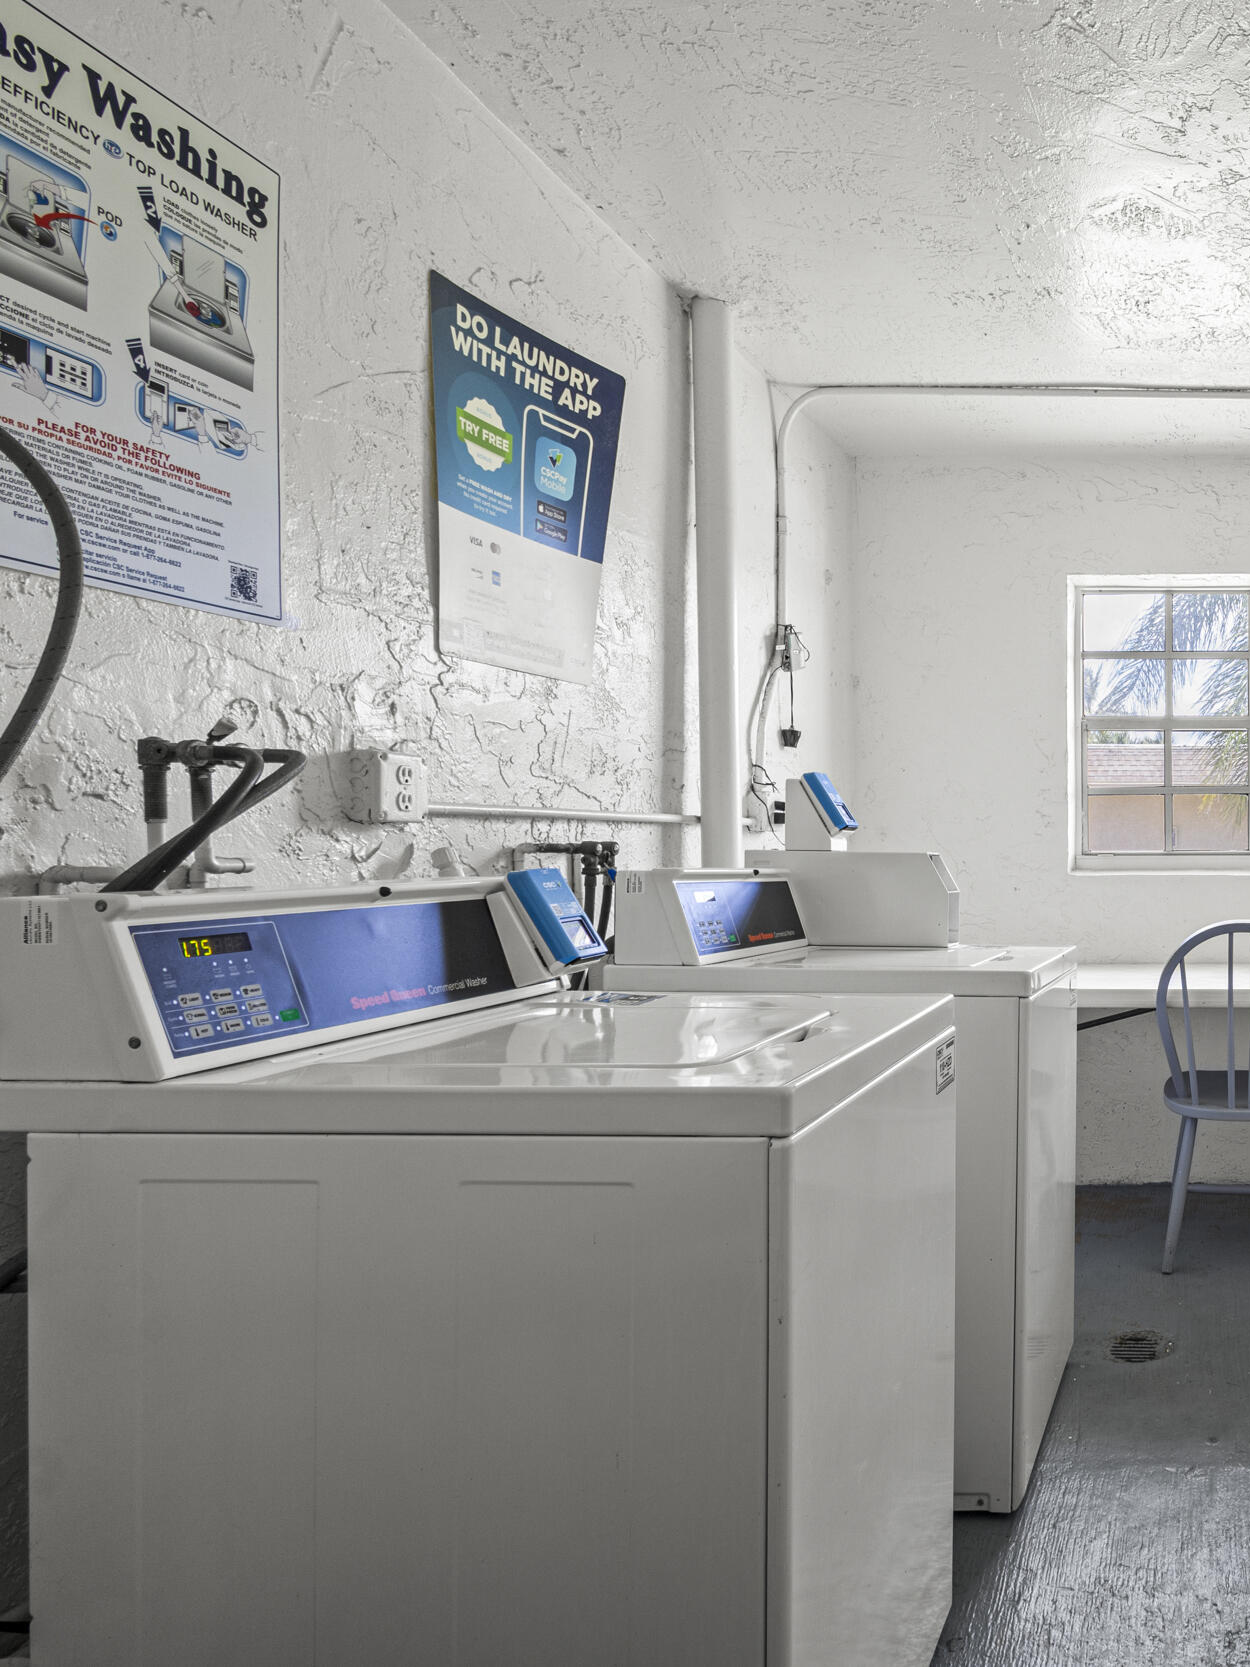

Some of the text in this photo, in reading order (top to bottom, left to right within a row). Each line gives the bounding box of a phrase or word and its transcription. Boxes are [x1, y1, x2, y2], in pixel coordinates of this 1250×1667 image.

[1, 75, 100, 148] EFFICIENCY
[126, 151, 155, 181] TOP
[160, 172, 198, 207] LOAD
[203, 198, 257, 242] WASHER
[81, 63, 269, 228] Washing
[97, 205, 122, 228] POD
[135, 354, 145, 366] 4
[457, 303, 598, 395] DO LAUNDRY
[154, 361, 176, 375] INSERT
[154, 367, 194, 389] INTRODUZCA
[450, 326, 601, 420] WITH THE APP
[75, 421, 170, 462] FOR YOUR SAFETY
[459, 416, 509, 452] TRY FREE
[17, 420, 230, 498] SU PROPIA SEGURIDAD, POR FAVOR EVITE LO SIGUIENTE
[37, 417, 200, 480] PLEASE AVOID THE FOLLOWING
[47, 440, 84, 457] CONTAINING
[50, 456, 75, 469] WASHER
[540, 465, 567, 485] CSCPay
[539, 475, 566, 495] Mobile
[13, 511, 23, 520] For
[25, 514, 48, 526] service
[80, 528, 93, 538] CSC
[469, 535, 482, 547] VISA
[351, 977, 487, 1010] Speed Queen Commercial Washer
